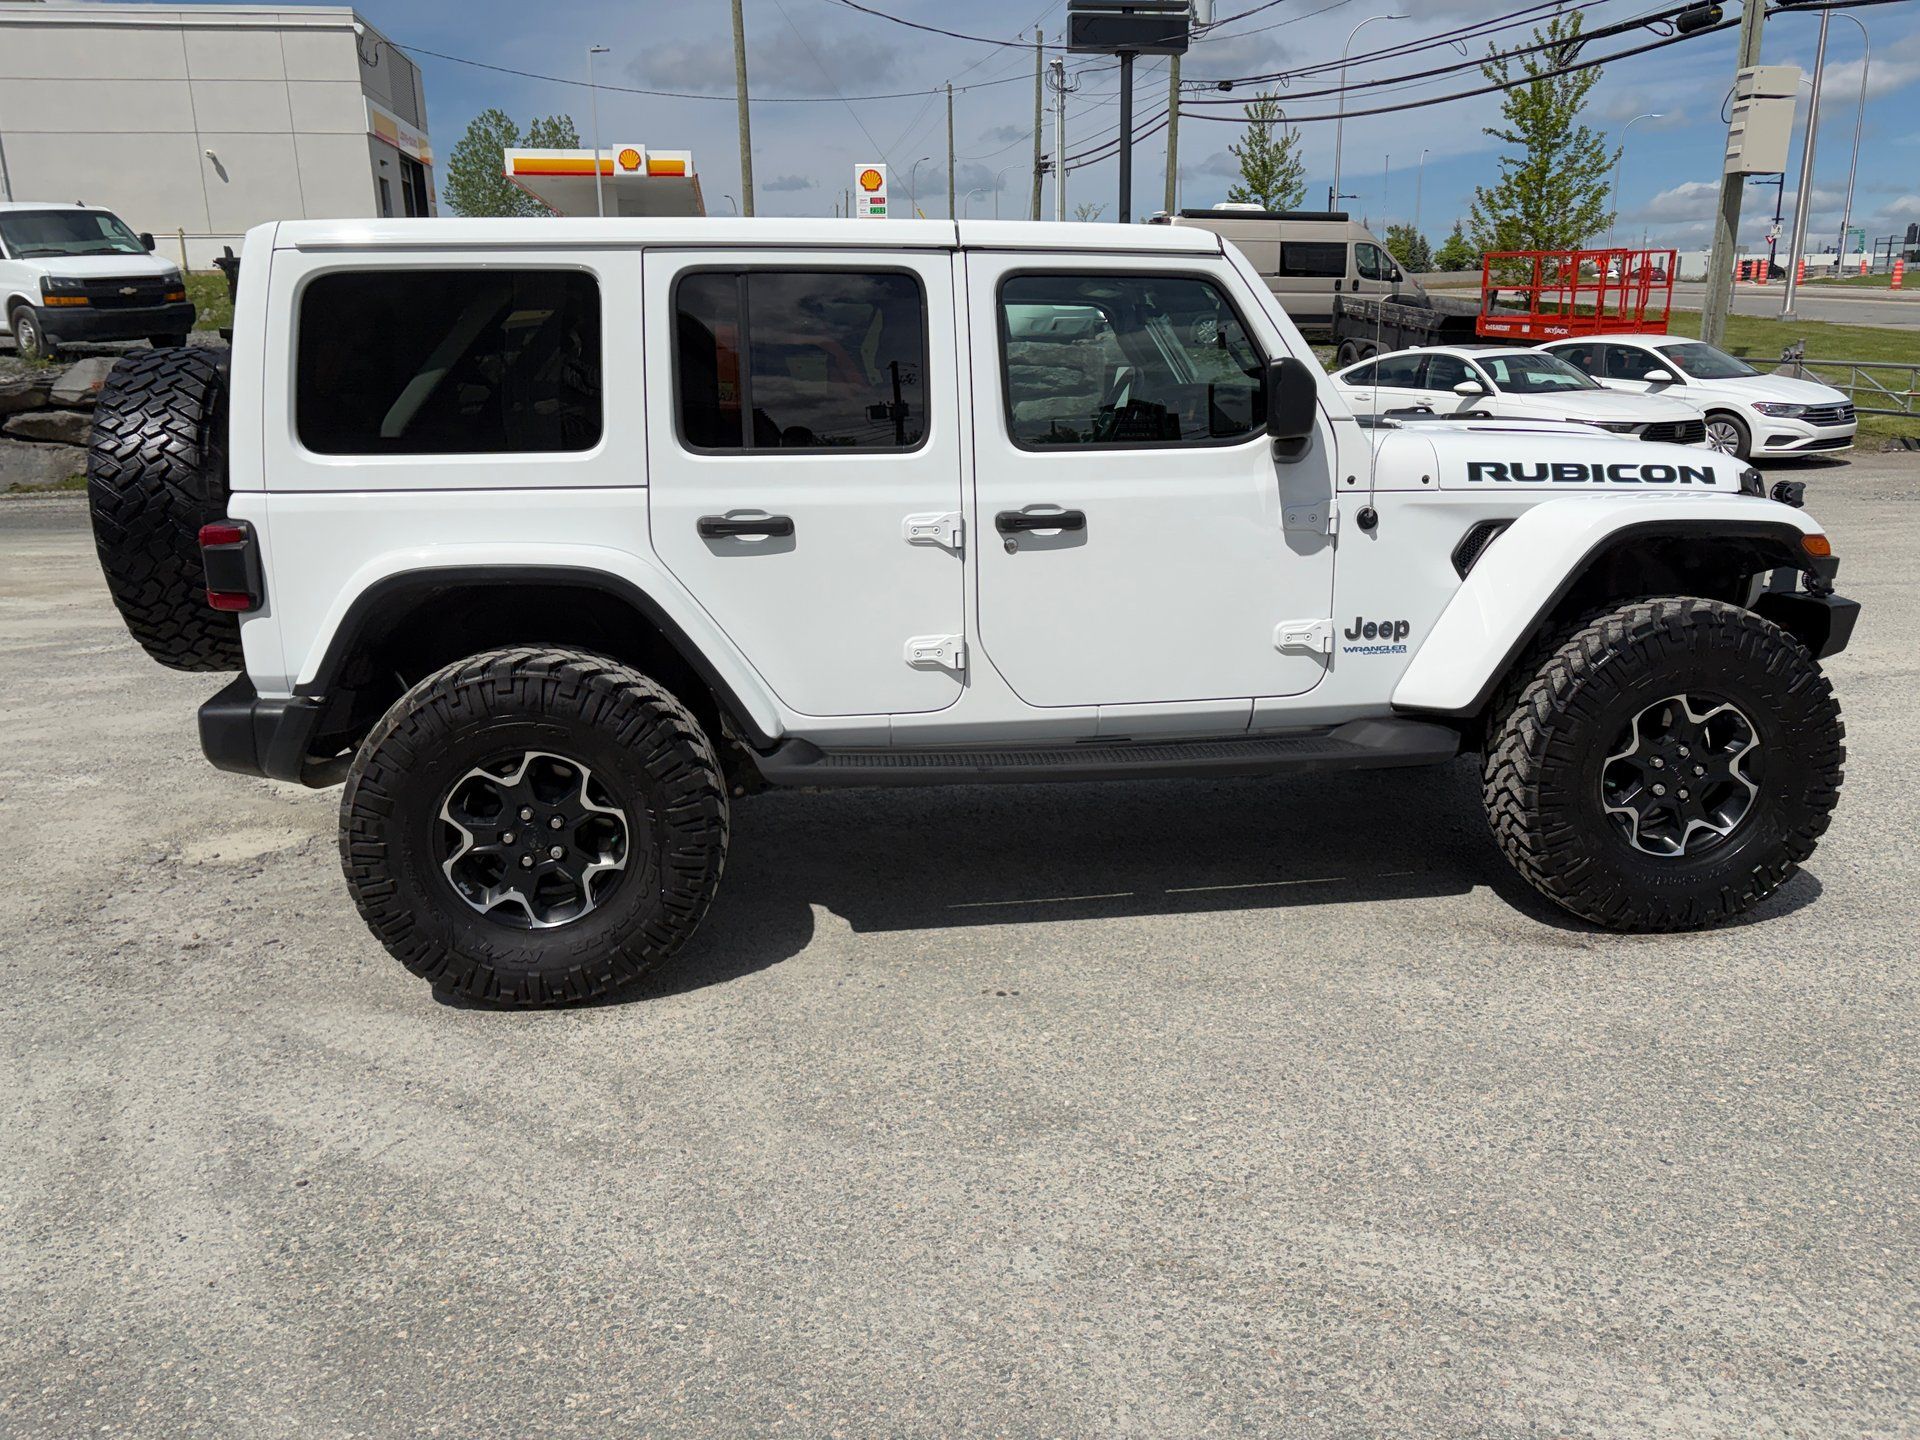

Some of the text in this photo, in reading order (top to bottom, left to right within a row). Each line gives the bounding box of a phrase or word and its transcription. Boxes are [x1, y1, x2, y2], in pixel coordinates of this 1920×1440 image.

[1544, 326, 1568, 335] SKYJACK
[1467, 462, 1716, 484] RUBICON
[1344, 616, 1410, 643] Jeep
[1343, 645, 1407, 653] WRANGLER
